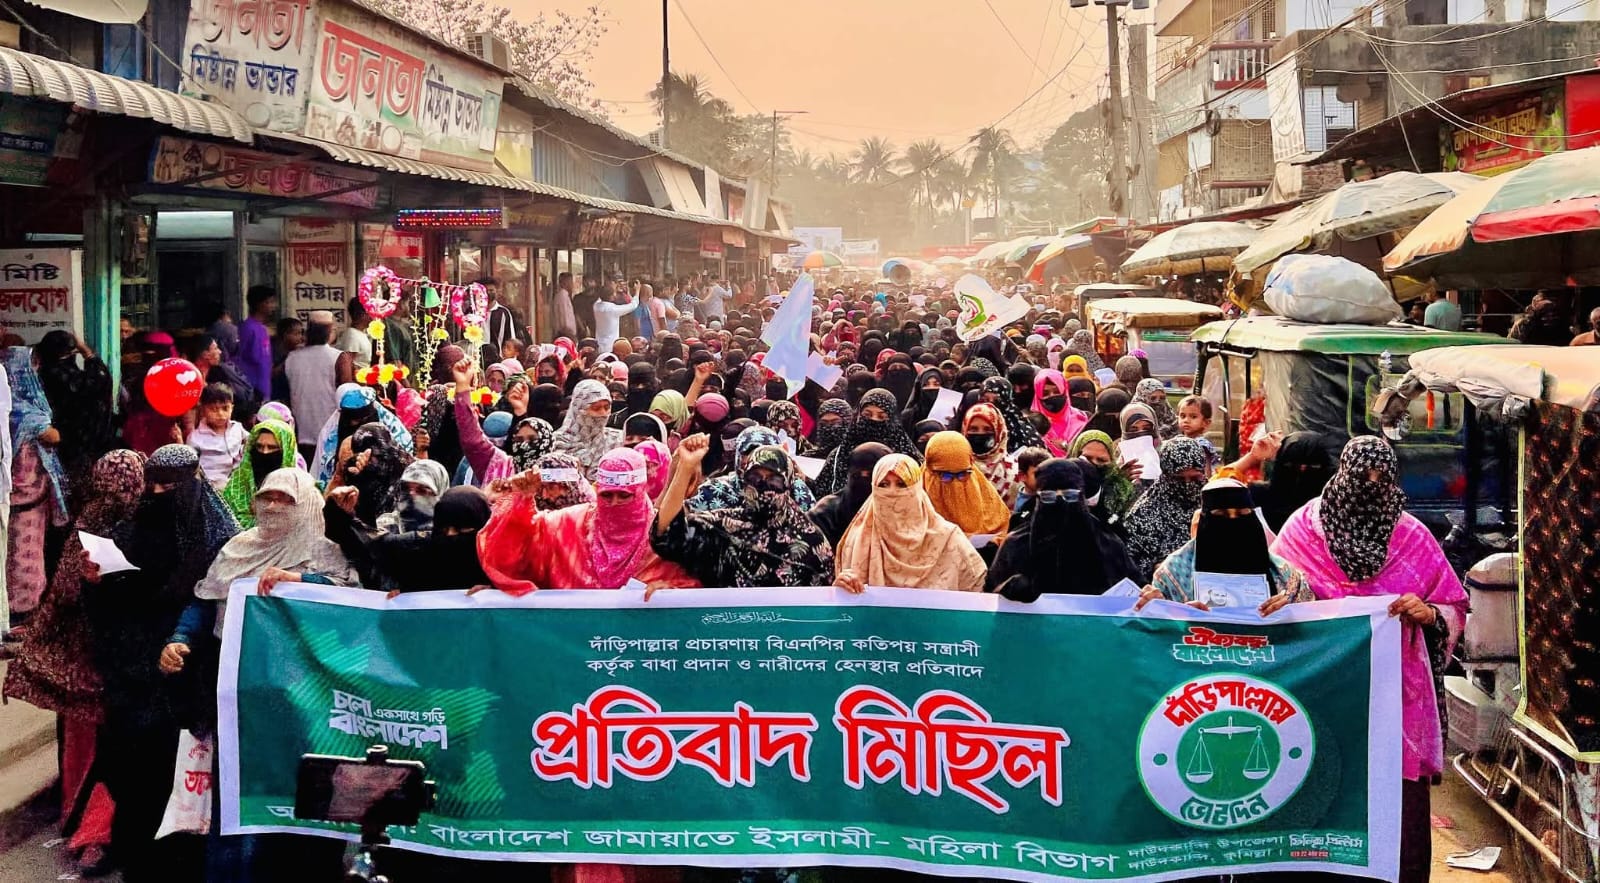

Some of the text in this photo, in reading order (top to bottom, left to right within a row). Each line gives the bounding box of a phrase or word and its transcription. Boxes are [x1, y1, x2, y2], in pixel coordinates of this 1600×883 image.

[190, 44, 239, 93] মিষ্টান্ন
[320, 19, 426, 127] জনতা
[0, 263, 60, 281] মিষ্টি
[286, 242, 347, 277] জনতা
[0, 286, 69, 313] জলযোগ
[294, 282, 346, 304] মিষ্টান্ন
[589, 635, 981, 657] দাঁড়িপাল্লার প্রচারণায় বিএনপির কতিপয় সন্ত্রাসী
[1172, 643, 1275, 665] বাংলাদেশ
[586, 654, 984, 679] কর্তৃক বাধা প্রদান ও নারীদের হেনস্থার প্রতিবাদে
[374, 708, 419, 722] একসাথে
[422, 707, 446, 724] গড়ি
[1163, 681, 1297, 728] দাঁড়িপাল্লায়
[329, 709, 448, 750] বাংলাদেশ
[532, 684, 1071, 814] প্রতিবাদ মিছিল
[428, 823, 572, 847] বাংলাদেশ
[582, 828, 739, 849] জামায়াতে
[902, 835, 1002, 860] মহিলা
[1014, 840, 1120, 873] বিভাগ
[1216, 835, 1284, 850] উপজেলা
